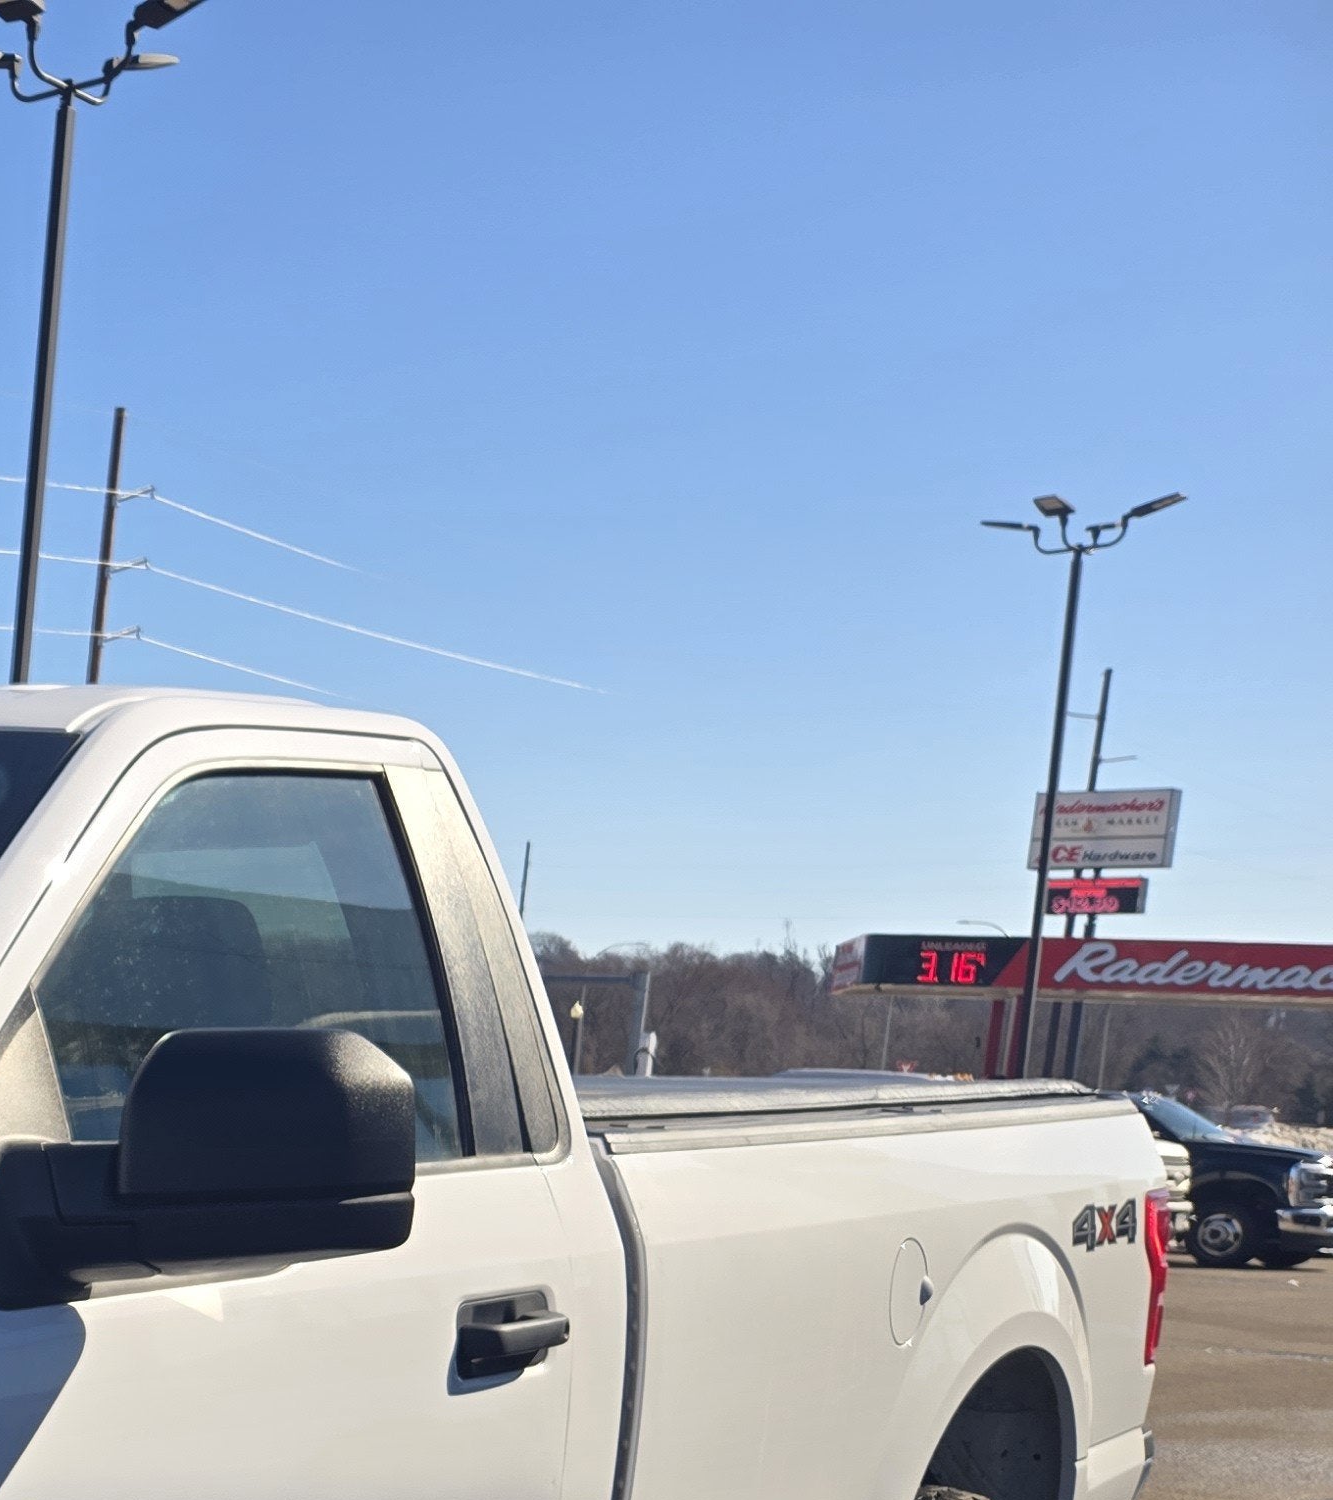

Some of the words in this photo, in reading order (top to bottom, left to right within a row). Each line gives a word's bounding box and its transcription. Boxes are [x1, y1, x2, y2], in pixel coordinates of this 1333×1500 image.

[1039, 799, 1165, 817] adermacher's
[1035, 844, 1082, 864] CE
[1082, 850, 1157, 862] Hardware
